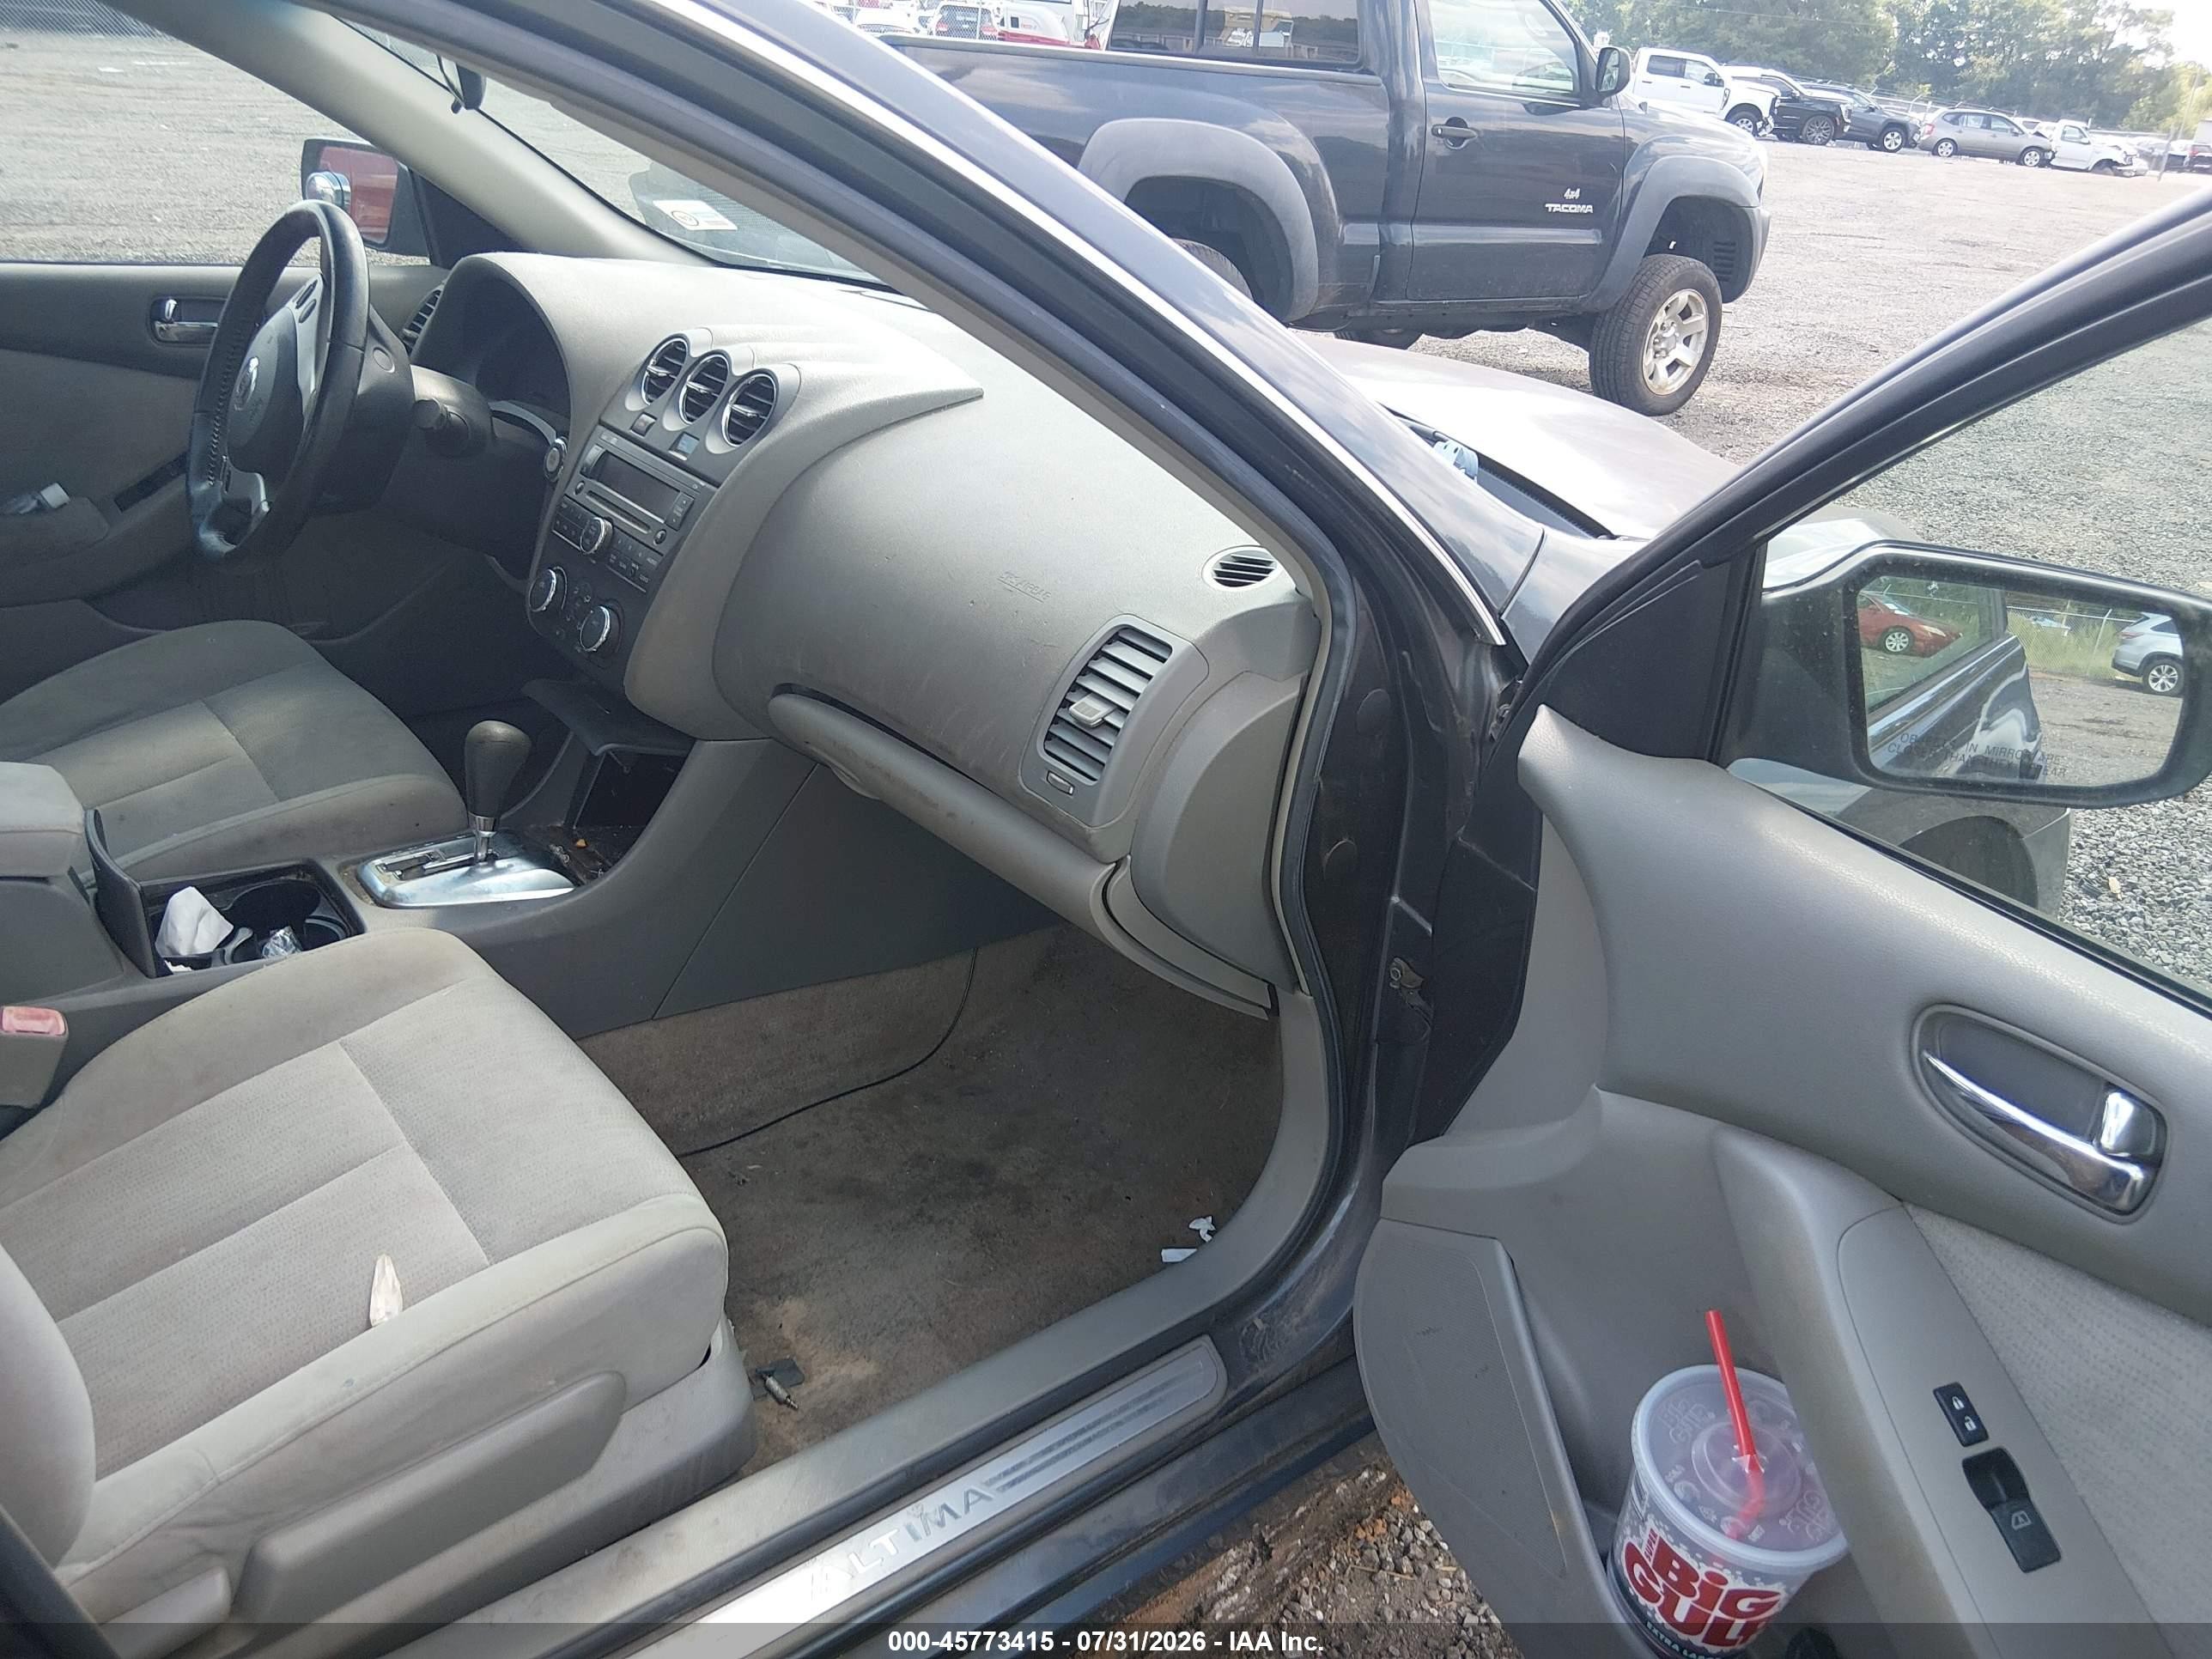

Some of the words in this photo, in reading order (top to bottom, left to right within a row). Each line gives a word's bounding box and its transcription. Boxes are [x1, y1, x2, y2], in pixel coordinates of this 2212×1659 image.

[1564, 188, 1581, 199] 4x4
[1545, 203, 1594, 214] TACOMA
[1965, 743, 1978, 752] IN
[1984, 744, 2029, 761] MIRRO
[1646, 1620, 1680, 1652] EXTRA
